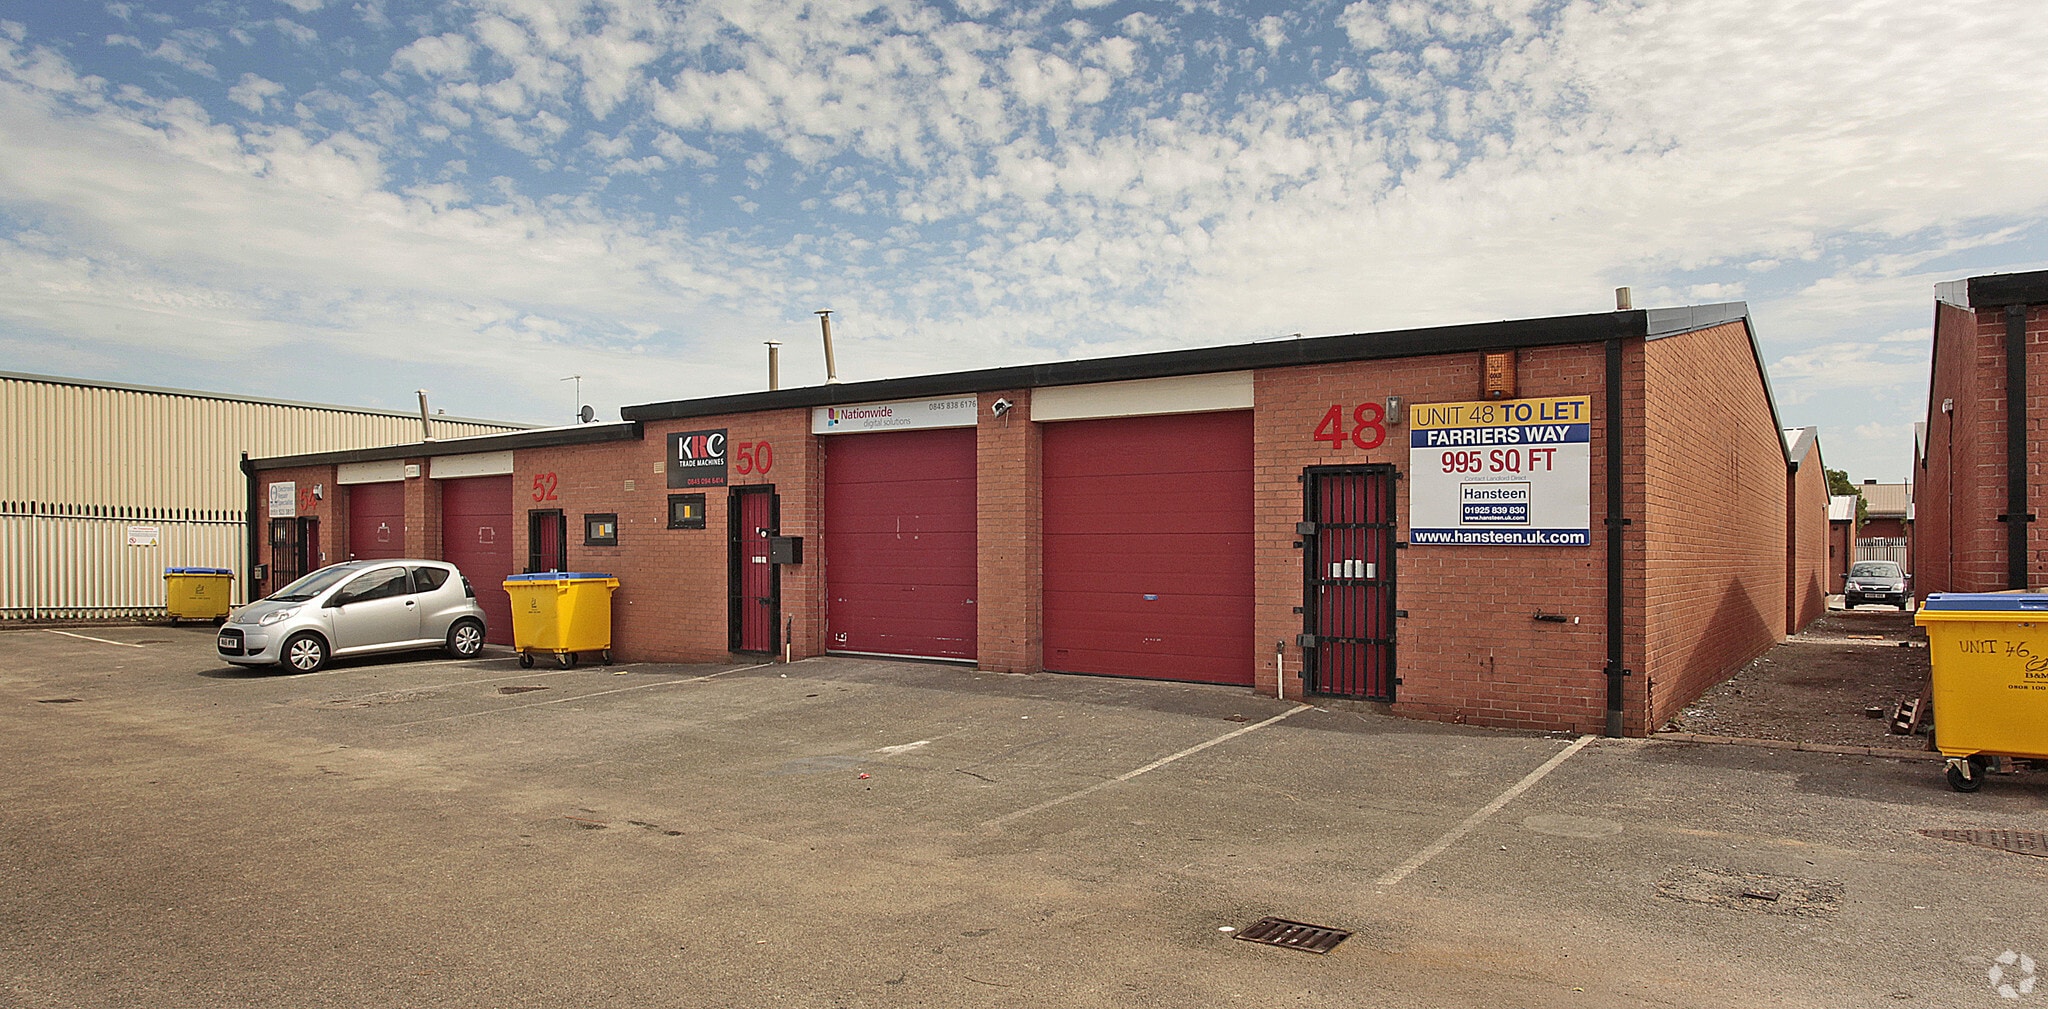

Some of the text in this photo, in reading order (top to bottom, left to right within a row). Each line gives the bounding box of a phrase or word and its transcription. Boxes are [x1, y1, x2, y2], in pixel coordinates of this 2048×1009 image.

[841, 406, 893, 420] Nationwide
[929, 403, 945, 411] 0845
[960, 401, 976, 409] 6176
[1417, 401, 1585, 427] UNIT 48 TO LET
[863, 418, 911, 429] digital solutions
[1313, 402, 1387, 450] 48
[1427, 425, 1570, 446] FARRIERS WAY
[678, 433, 725, 460] KRC
[680, 458, 724, 468] TRADE MACHINES
[736, 440, 773, 475] 50
[1441, 447, 1557, 474] 995 SQ FT
[532, 471, 558, 502] 52
[1464, 488, 1526, 499] Hansteen
[300, 486, 317, 511] 54
[1464, 506, 1525, 514] 01925 839 830
[1415, 529, 1585, 545] www.hansteen.uk.com
[1959, 640, 2030, 658] UNIT 46
